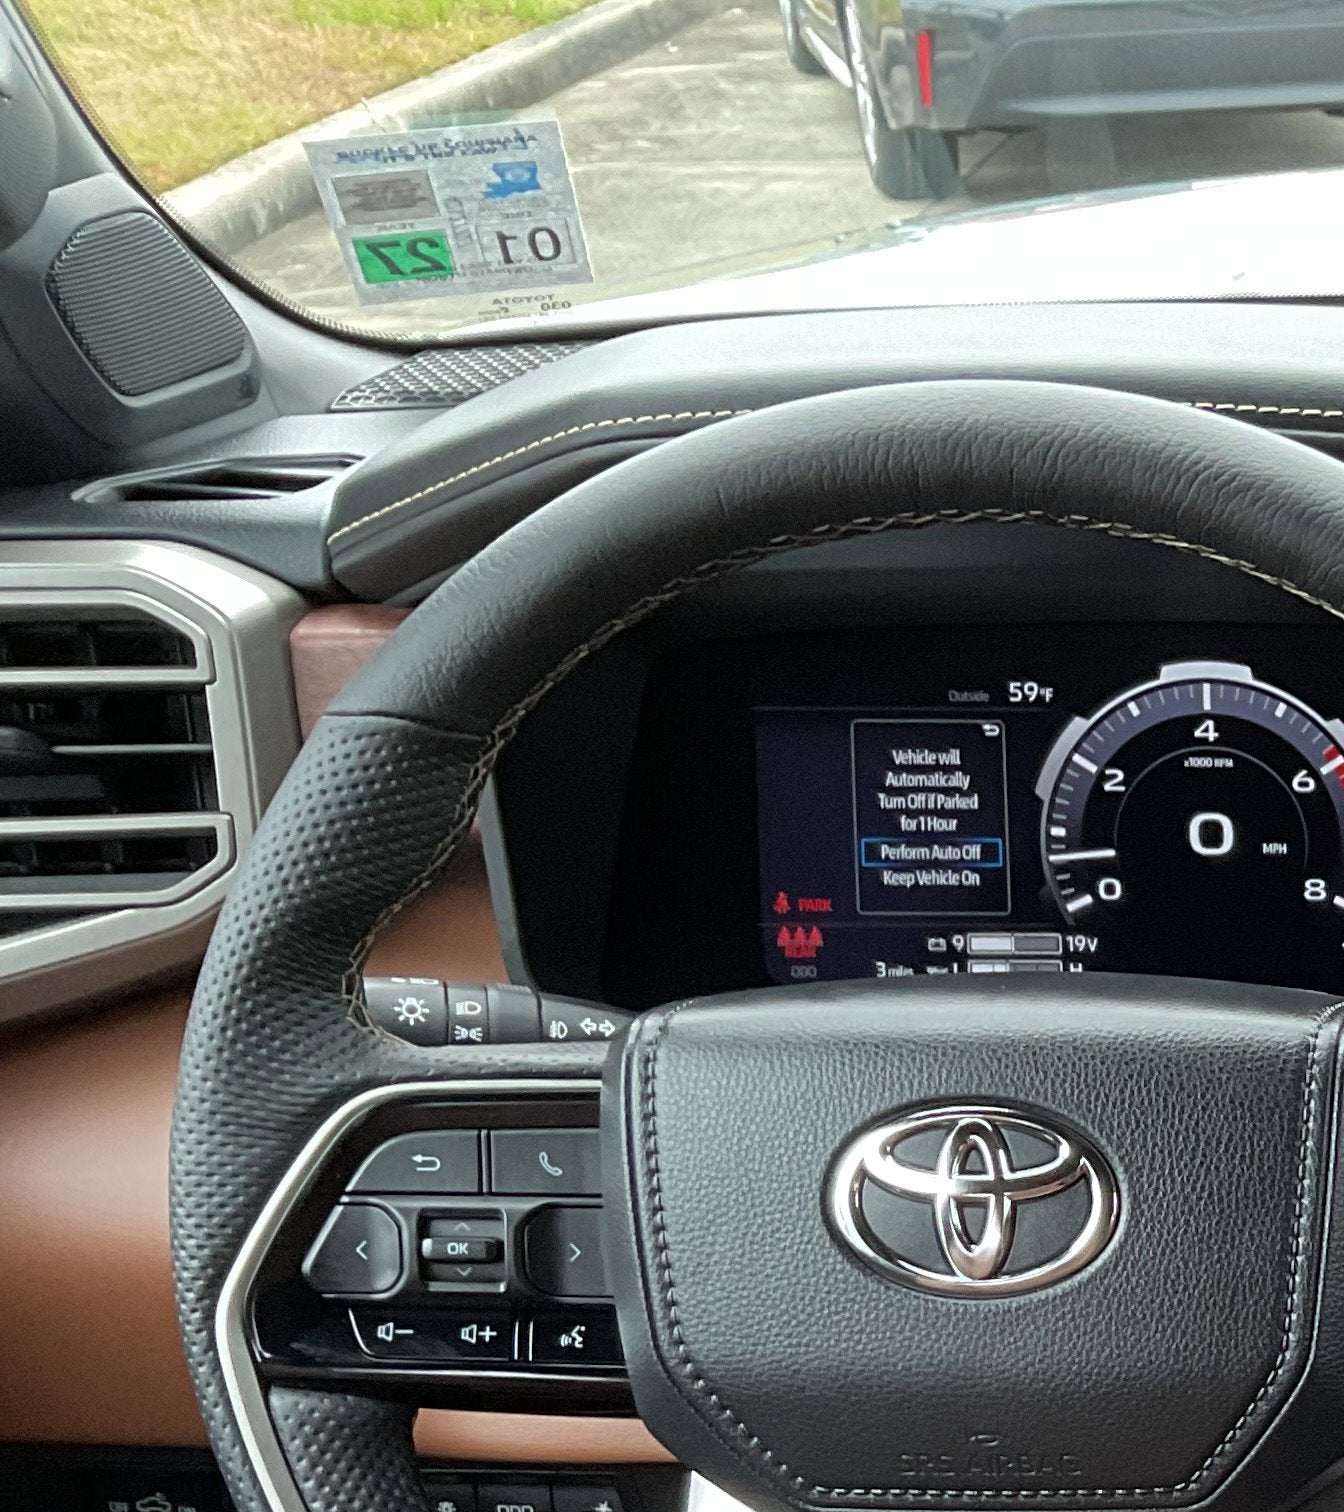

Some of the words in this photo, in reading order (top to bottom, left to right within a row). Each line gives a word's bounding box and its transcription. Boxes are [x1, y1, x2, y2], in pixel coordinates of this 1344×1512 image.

[1192, 719, 1220, 743] 4
[892, 749, 936, 765] Vehicle
[937, 749, 961, 765] will
[1214, 758, 1233, 768] RPM
[886, 771, 970, 790] Automatically
[1102, 770, 1127, 792] 2
[1292, 769, 1316, 793] 6
[878, 793, 906, 809] Turn
[907, 793, 925, 809] Off
[927, 793, 936, 809] if
[937, 793, 979, 809] Parked
[900, 815, 918, 831] for
[920, 816, 926, 831] 1
[927, 816, 958, 831] Hour
[1189, 812, 1234, 856] 0
[881, 844, 930, 860] Perform
[931, 844, 960, 860] Auto
[962, 844, 981, 860] Off
[1262, 843, 1287, 855] MPH
[883, 870, 915, 888] Keep
[916, 869, 960, 886] Vehicle
[962, 870, 980, 886] On
[1098, 879, 1122, 901] 0
[1304, 879, 1328, 901] 8
[953, 934, 965, 952] 9
[875, 961, 887, 978] 3
[447, 1243, 468, 1255] OK
